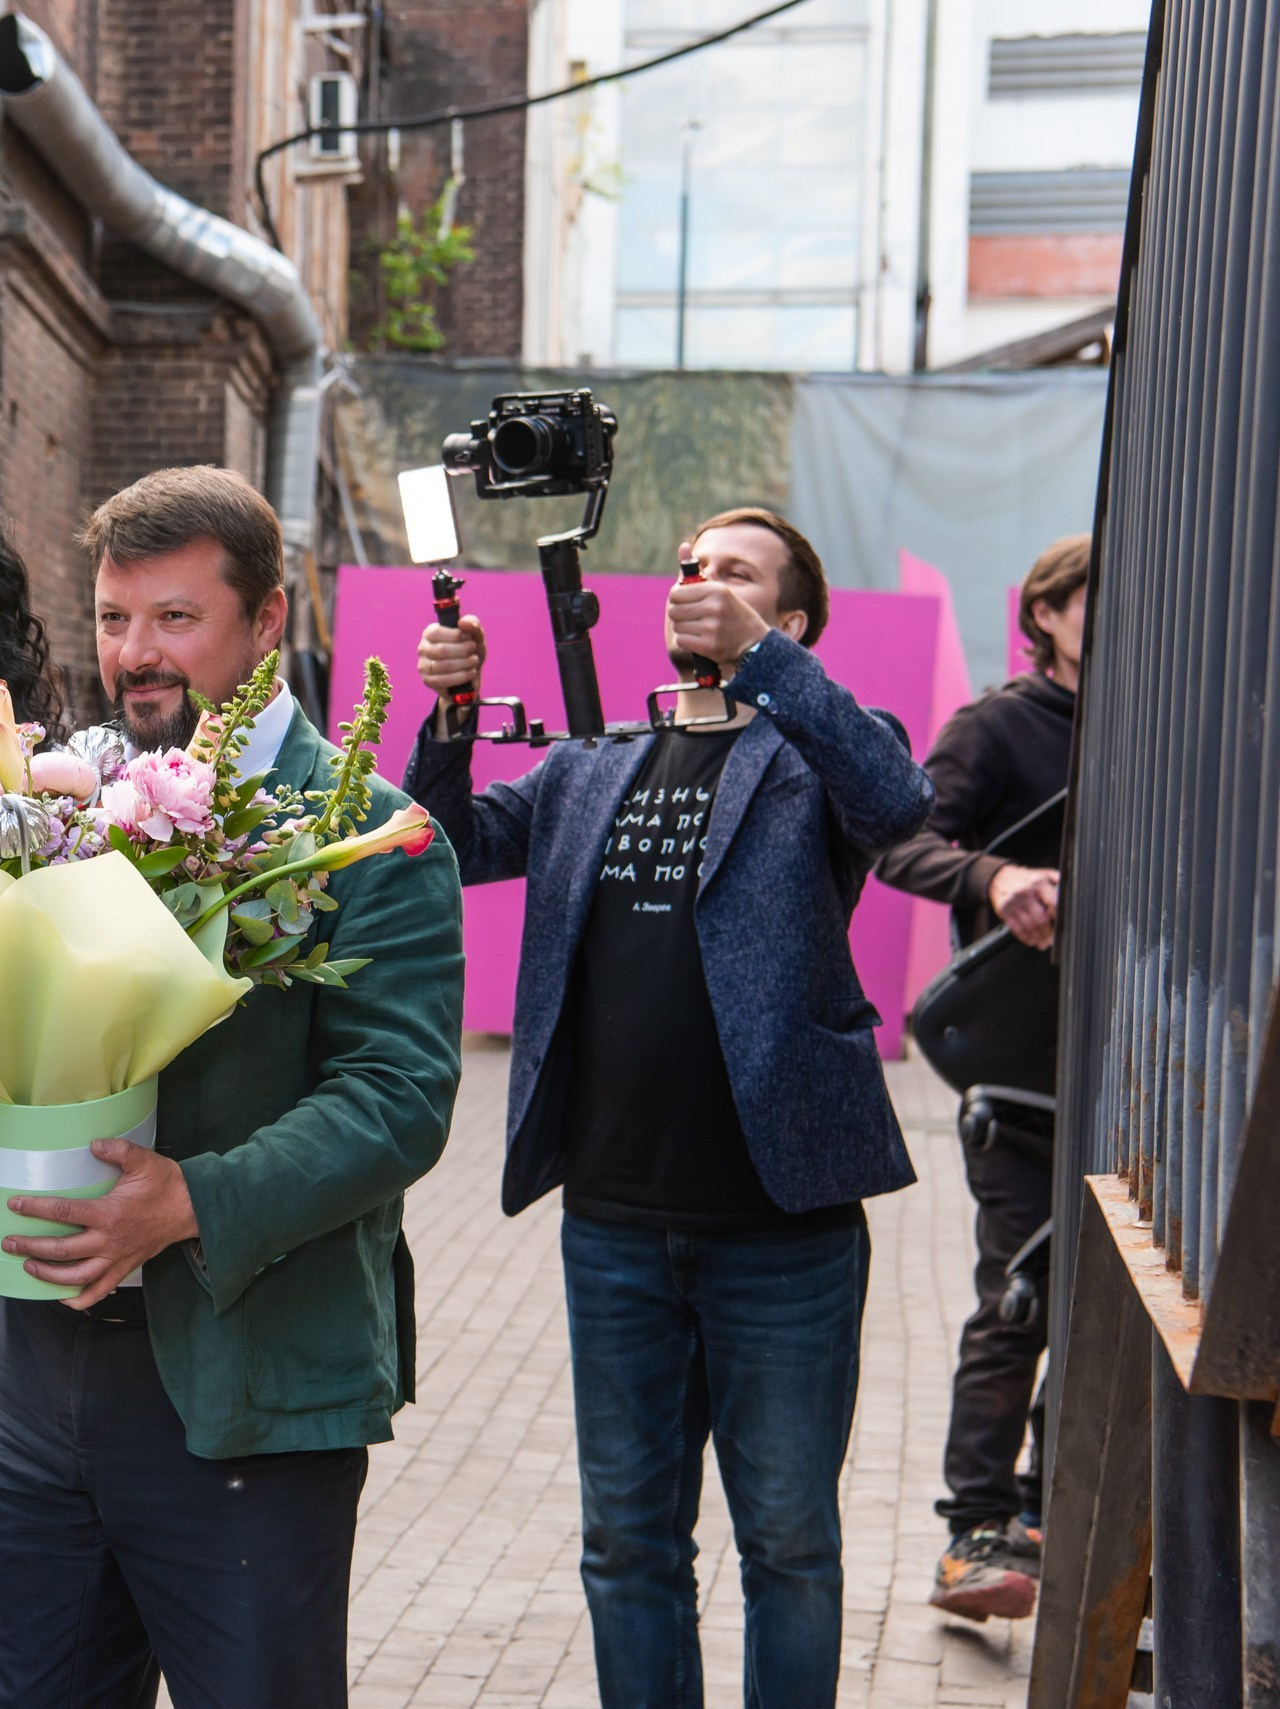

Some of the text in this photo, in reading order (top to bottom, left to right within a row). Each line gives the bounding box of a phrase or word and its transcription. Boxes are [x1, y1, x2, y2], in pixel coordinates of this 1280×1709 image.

[623, 786, 710, 807] ИЗНЬ
[615, 812, 662, 828] МА
[654, 864, 686, 882] ПО
